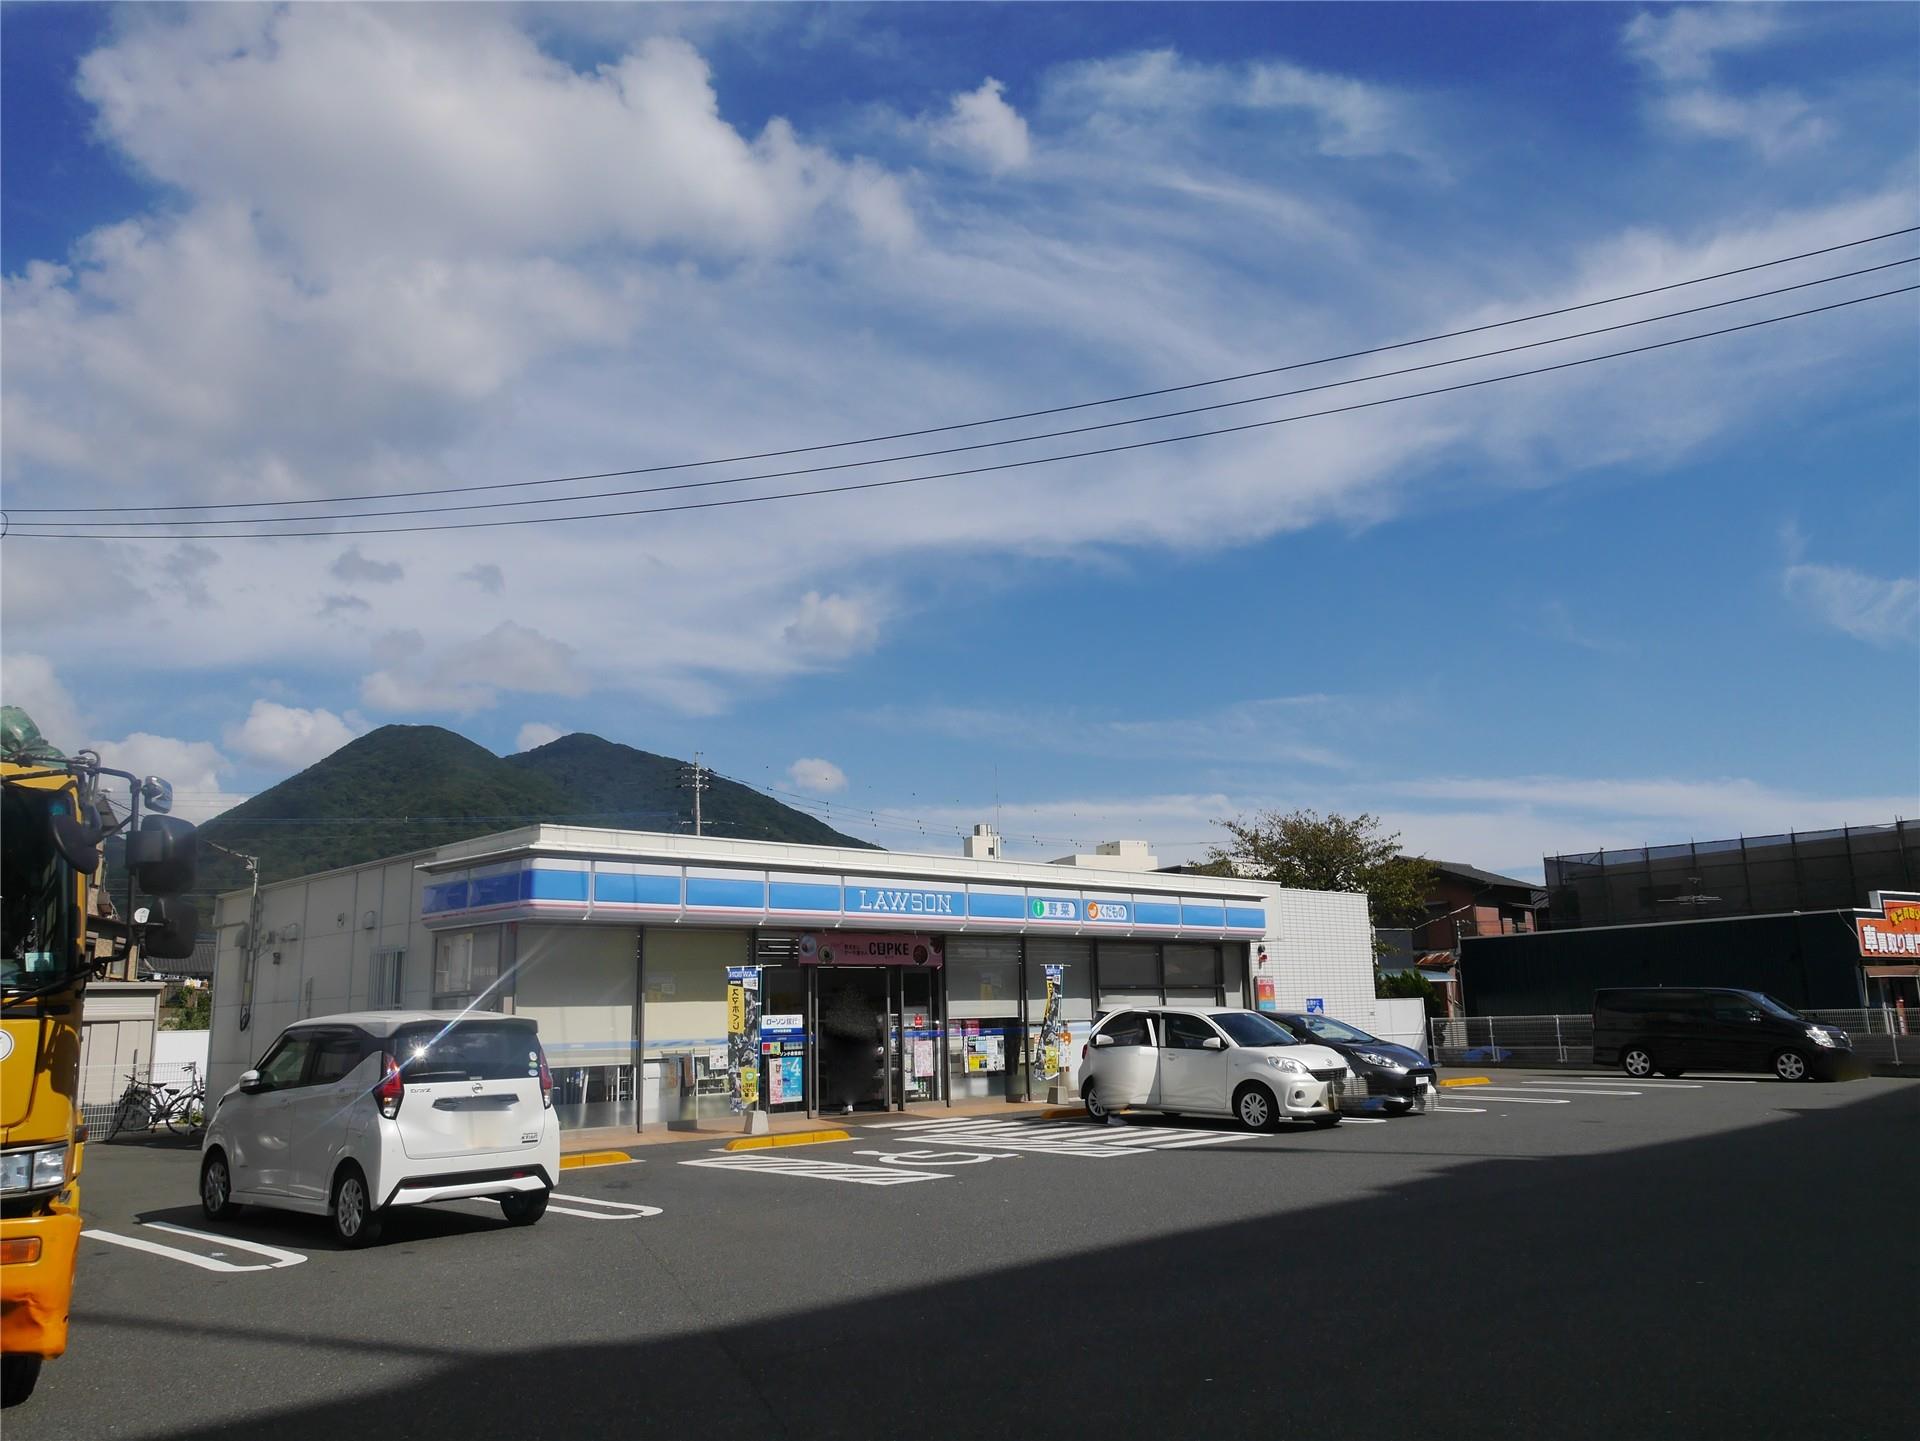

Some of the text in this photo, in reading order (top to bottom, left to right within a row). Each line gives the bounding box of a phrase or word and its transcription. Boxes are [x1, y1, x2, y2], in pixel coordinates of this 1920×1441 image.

[859, 890, 952, 913] LAWSON
[1048, 902, 1070, 917] 野菜
[1100, 905, 1125, 919] くだもの
[868, 942, 910, 956] CUPKE
